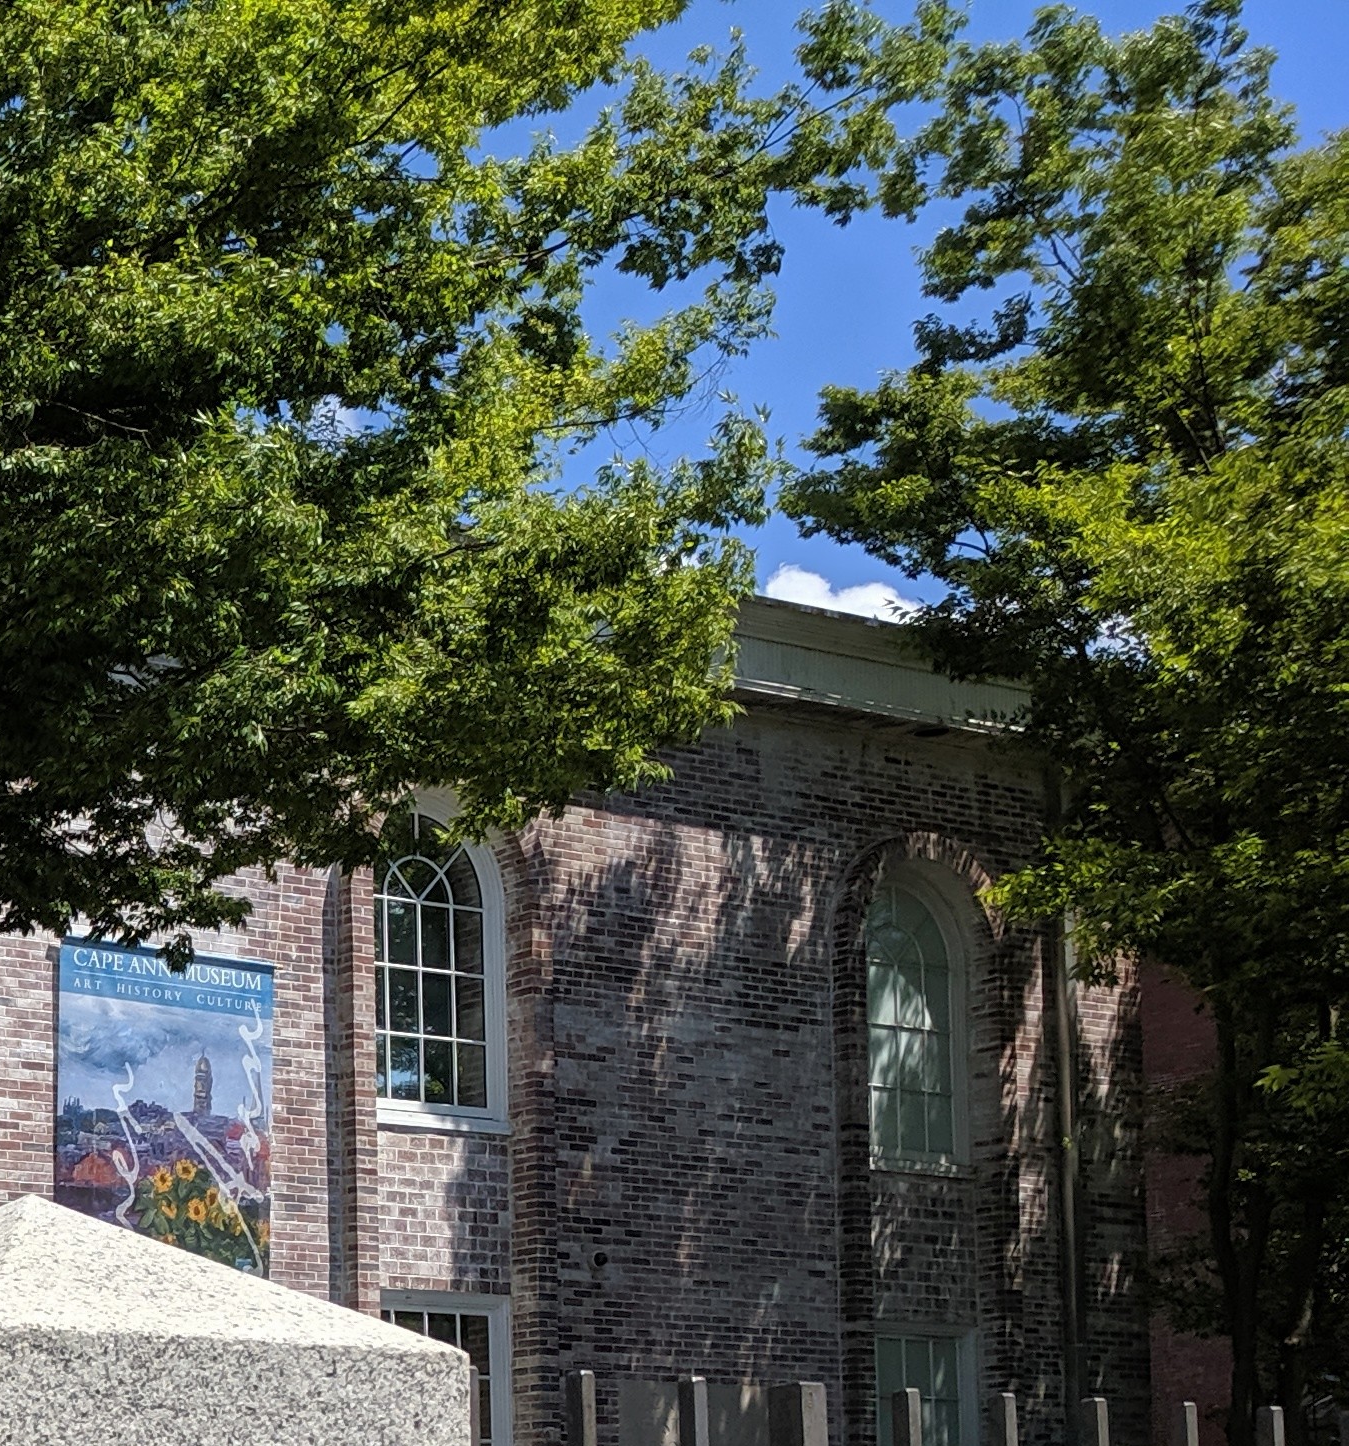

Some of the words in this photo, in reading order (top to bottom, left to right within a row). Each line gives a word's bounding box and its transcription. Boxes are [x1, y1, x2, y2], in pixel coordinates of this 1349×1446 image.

[73, 949, 124, 971] CAPE
[128, 959, 171, 976] ANN
[74, 977, 101, 990] ART
[116, 983, 182, 1001] HISTORY
[196, 994, 262, 1012] CULTURE
